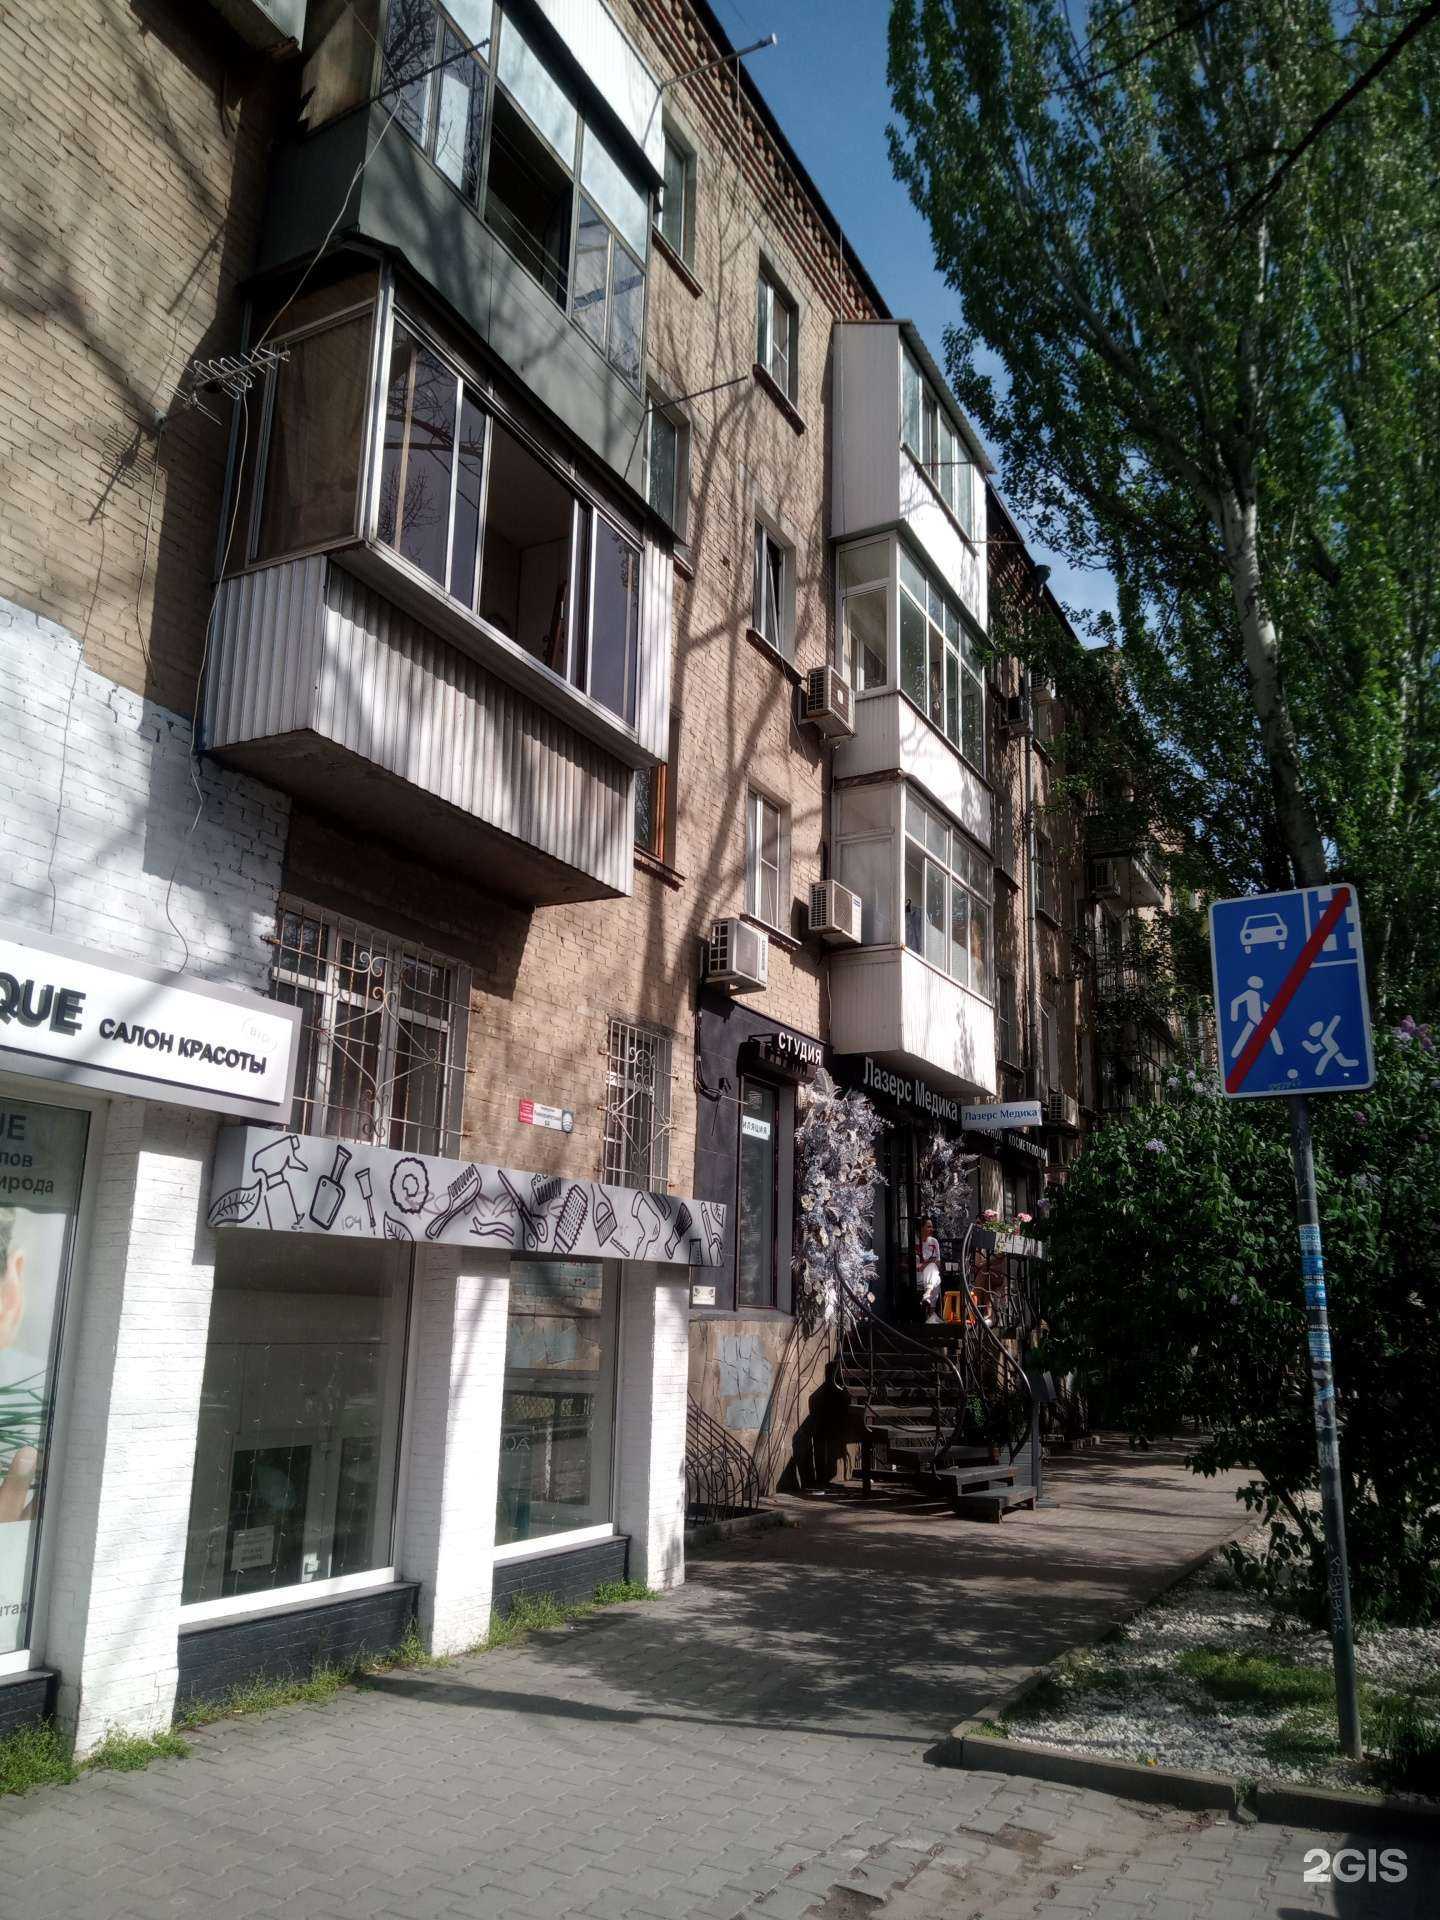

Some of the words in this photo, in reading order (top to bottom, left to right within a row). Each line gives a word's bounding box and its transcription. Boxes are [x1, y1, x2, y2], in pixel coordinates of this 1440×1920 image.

[99, 1018, 175, 1054] САЛОН
[178, 1036, 267, 1075] КРАСОТЫ
[778, 1031, 822, 1066] СТУДИЯ
[863, 1056, 913, 1106] Лазерс
[915, 1079, 958, 1122] Медика
[964, 1111, 998, 1122] Лазерс
[1000, 1109, 1038, 1121] Медика
